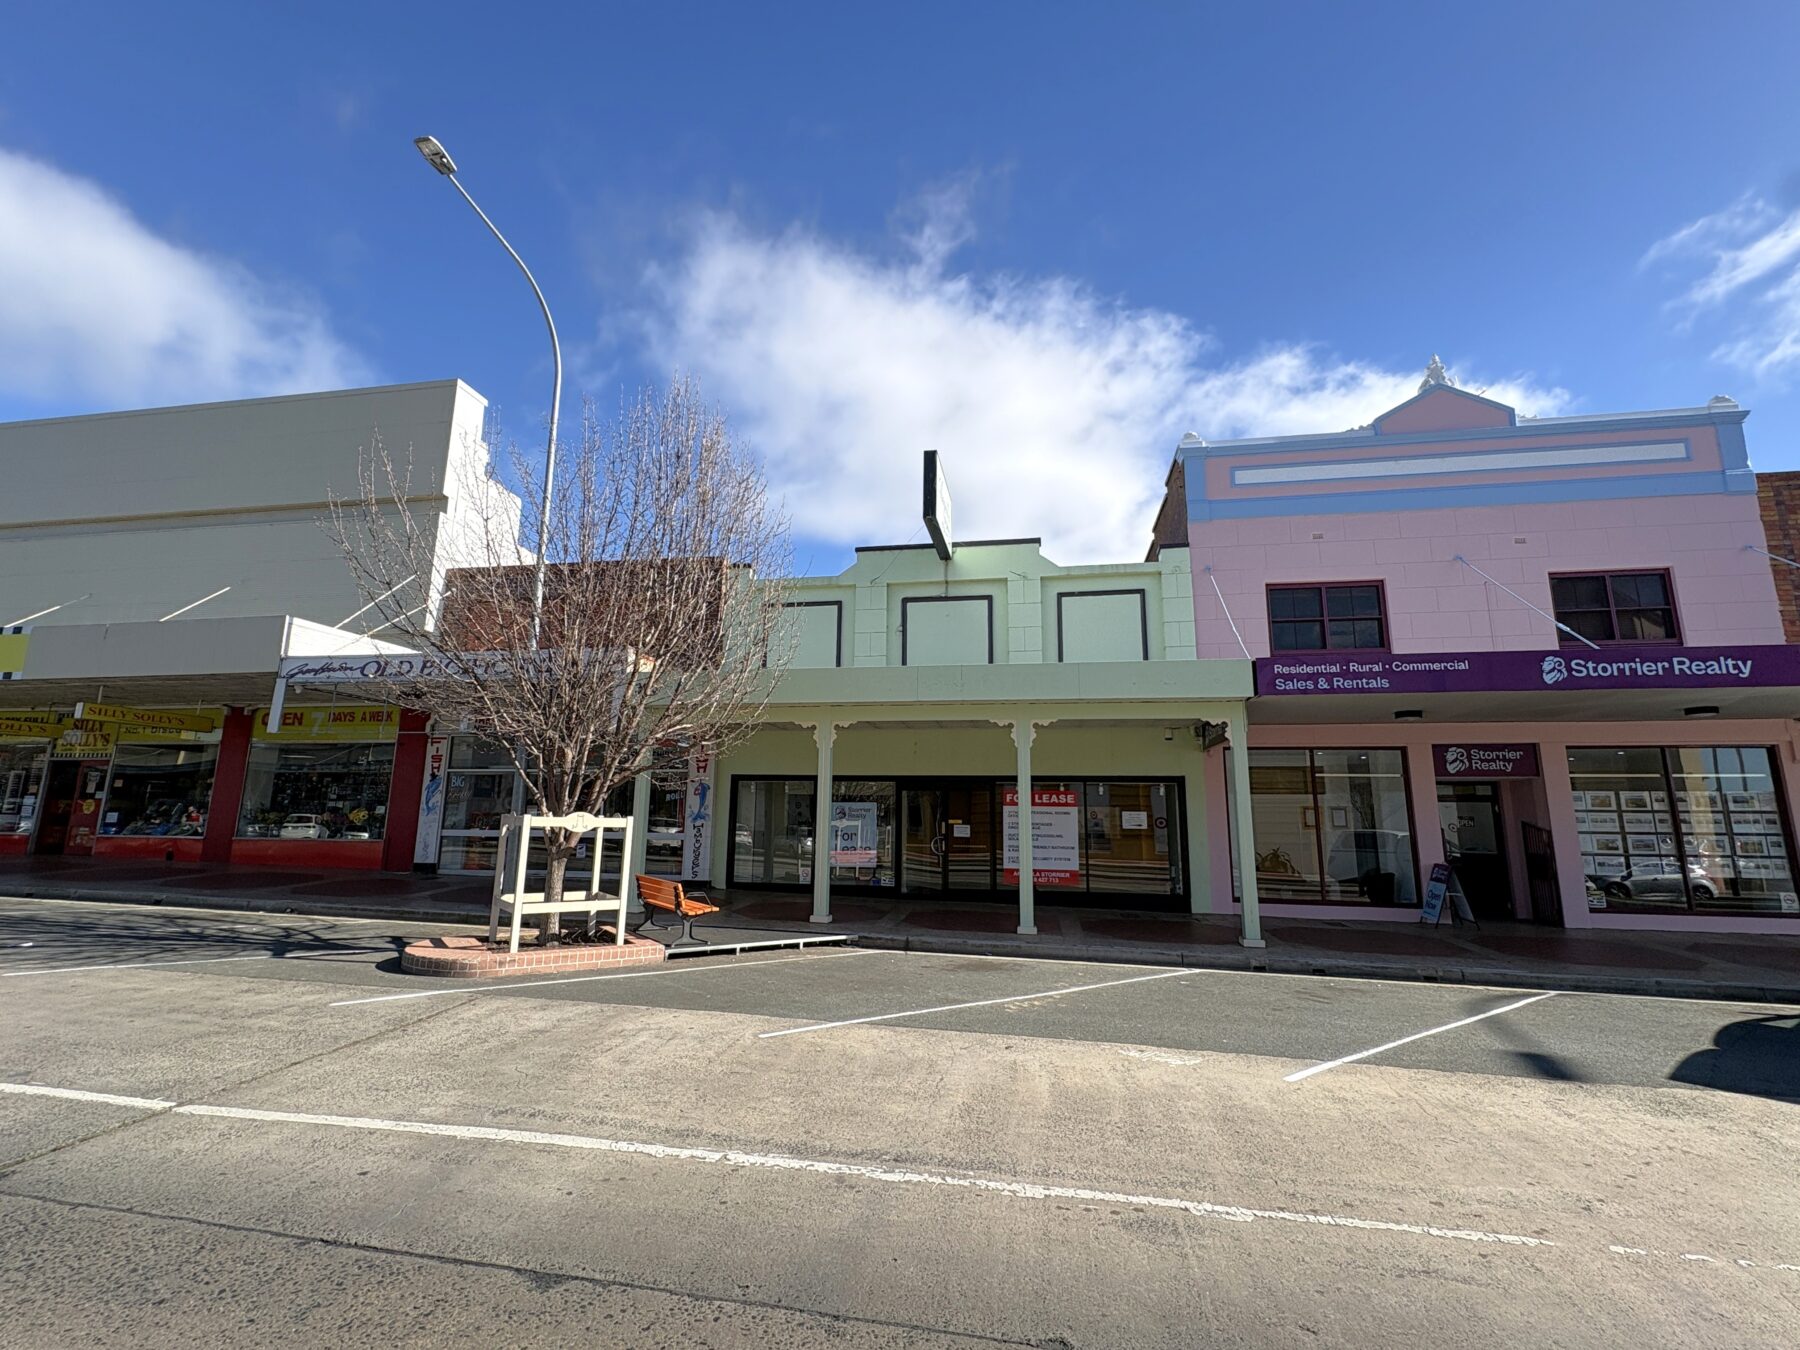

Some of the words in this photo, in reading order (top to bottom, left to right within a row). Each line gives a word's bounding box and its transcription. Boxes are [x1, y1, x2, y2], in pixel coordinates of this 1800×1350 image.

[1273, 662, 1340, 675] Residential
[1348, 661, 1382, 673] Rural
[1391, 659, 1469, 672] Commercial
[1570, 658, 1669, 678] Storrier
[1672, 656, 1752, 678] Realty
[1275, 677, 1314, 690] Sales
[1317, 678, 1330, 690] &
[1333, 675, 1390, 689] Rentals
[88, 707, 128, 719] SILLY
[133, 712, 185, 725] SOLLY'S
[261, 712, 304, 726] OEN
[328, 711, 356, 723] DAYS
[360, 711, 367, 723] A
[0, 722, 47, 733] OLLY'S
[73, 719, 105, 732] SILLY
[62, 733, 111, 747] SOLLY'S
[1470, 748, 1523, 760] Storrier
[1471, 759, 1513, 772] Realty
[451, 775, 465, 788] BIG
[1034, 794, 1076, 804] LEASE
[835, 829, 857, 842] For
